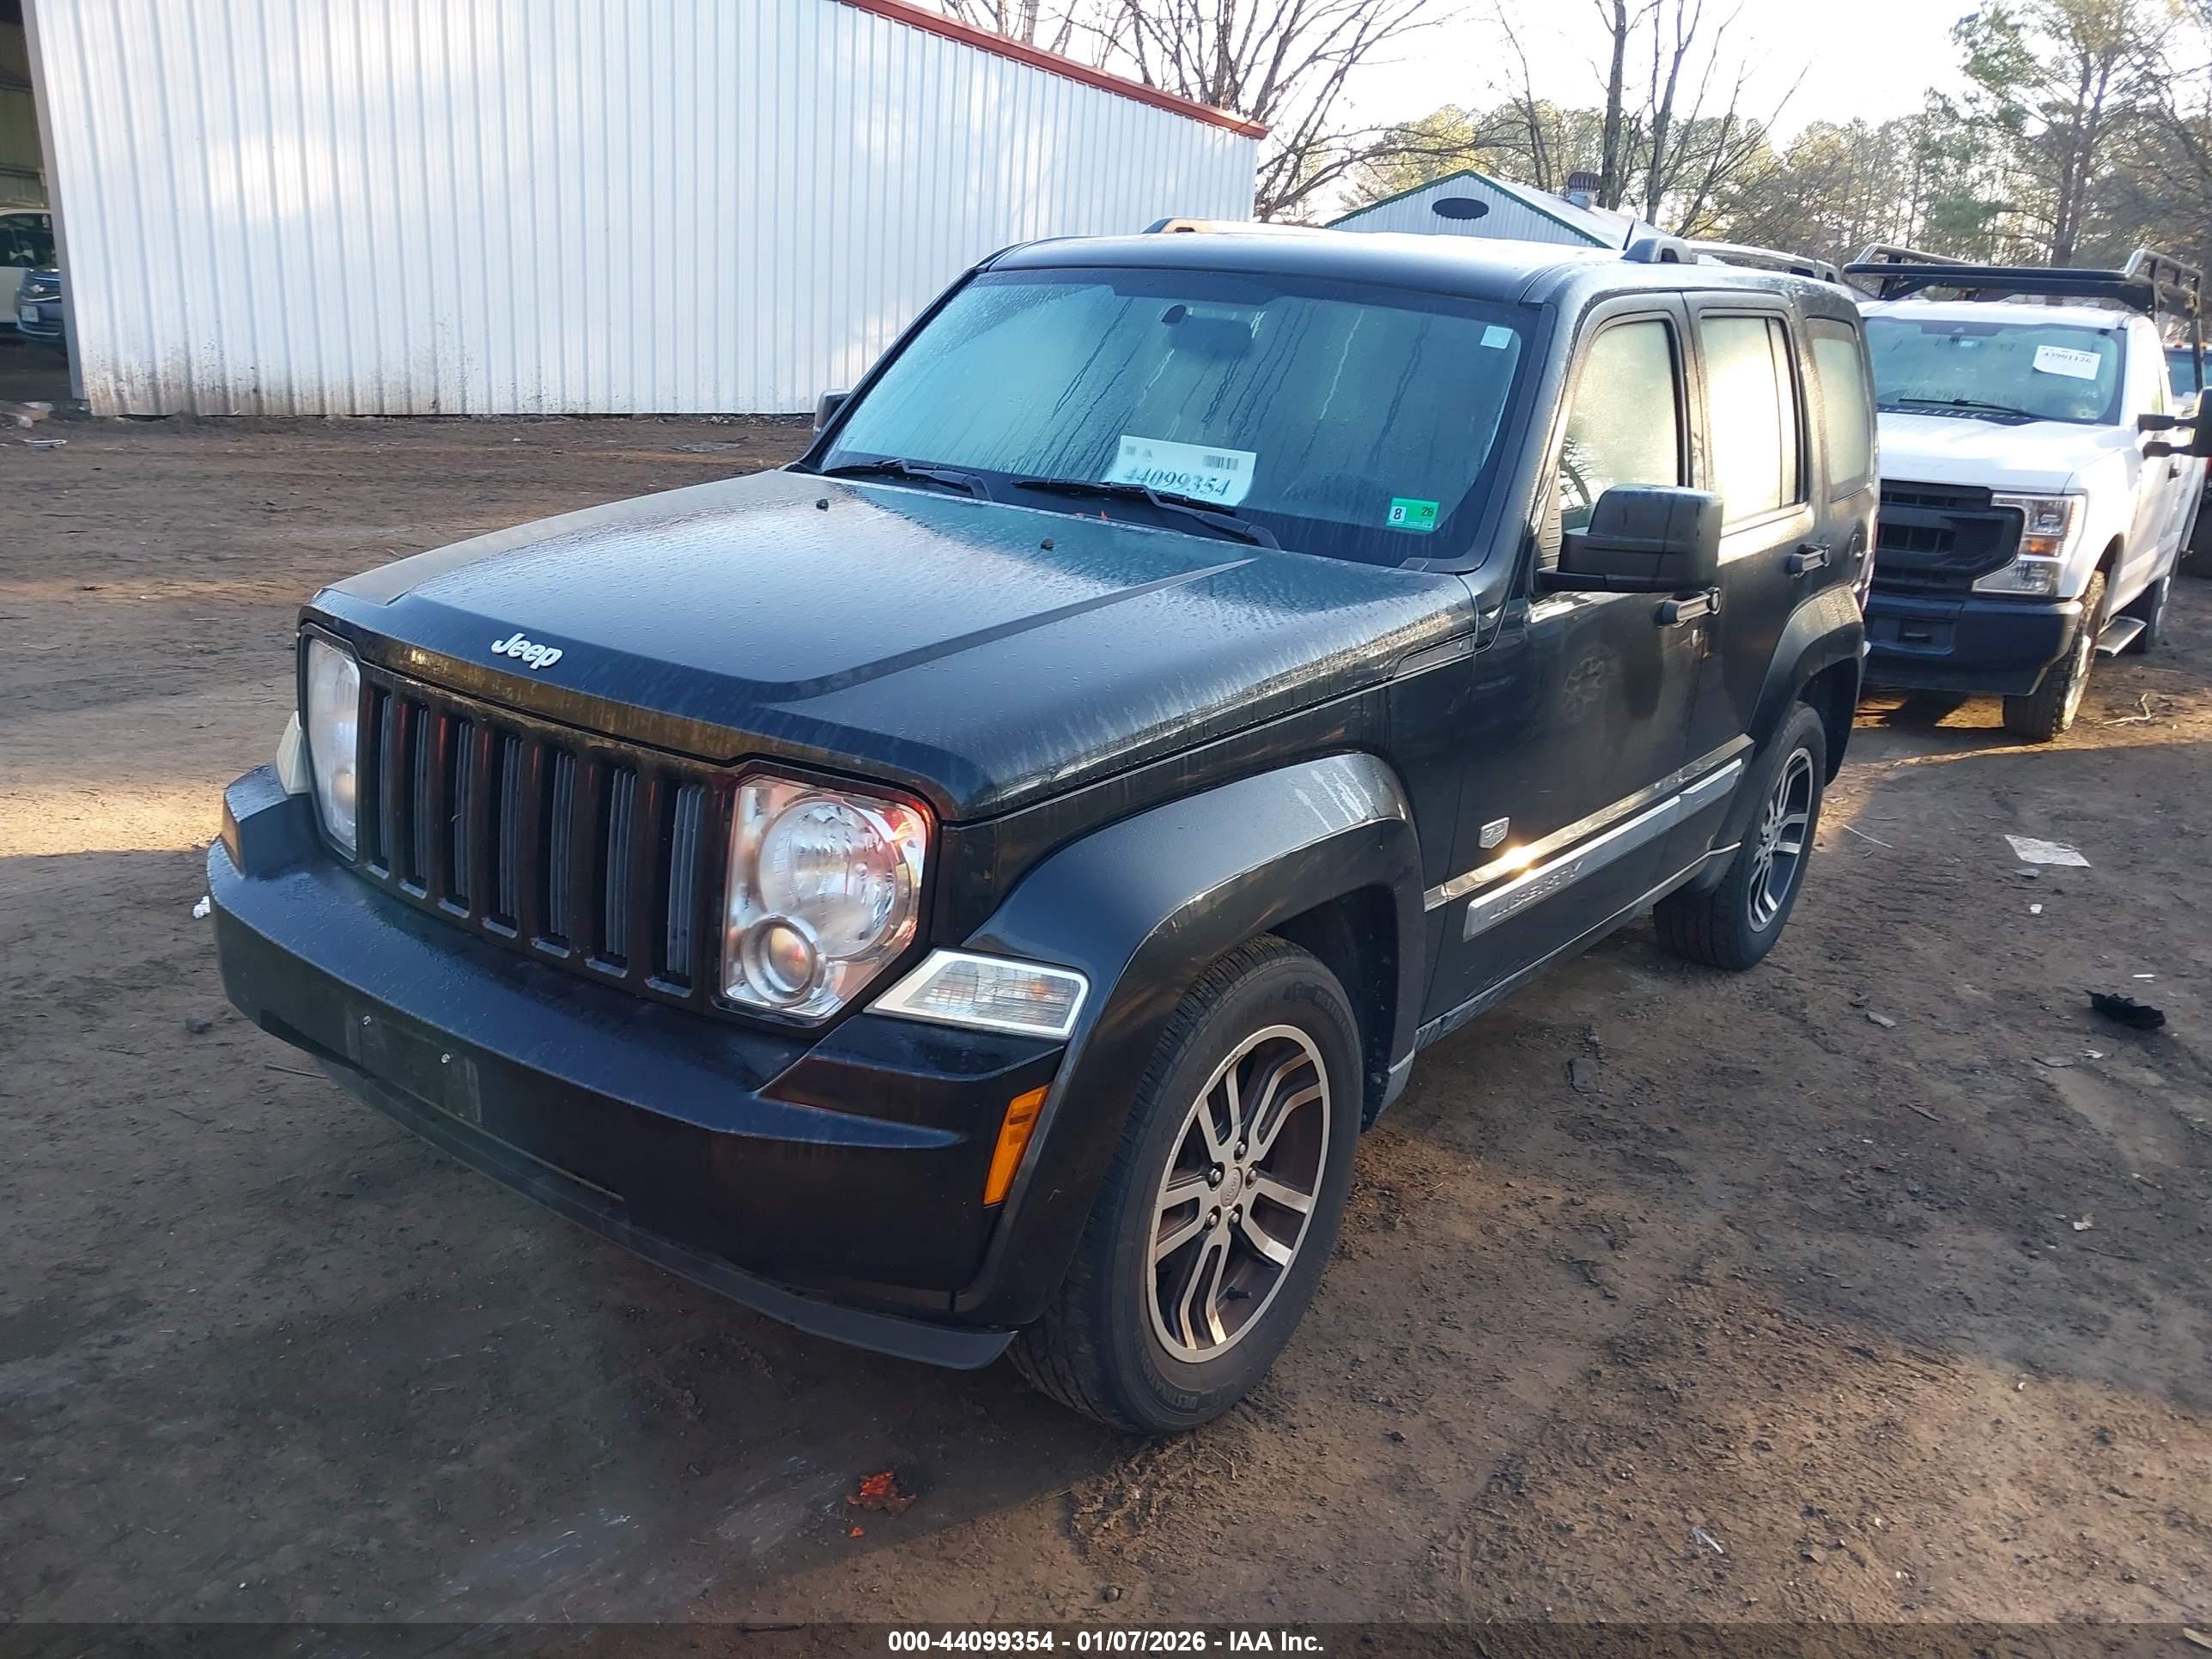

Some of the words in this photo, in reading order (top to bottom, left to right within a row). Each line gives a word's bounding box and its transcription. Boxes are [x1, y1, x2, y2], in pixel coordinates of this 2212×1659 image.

[1123, 466, 1231, 496] 44099354
[1394, 507, 1402, 520] 8
[1421, 507, 1435, 517] 26
[490, 632, 563, 670] Jeep
